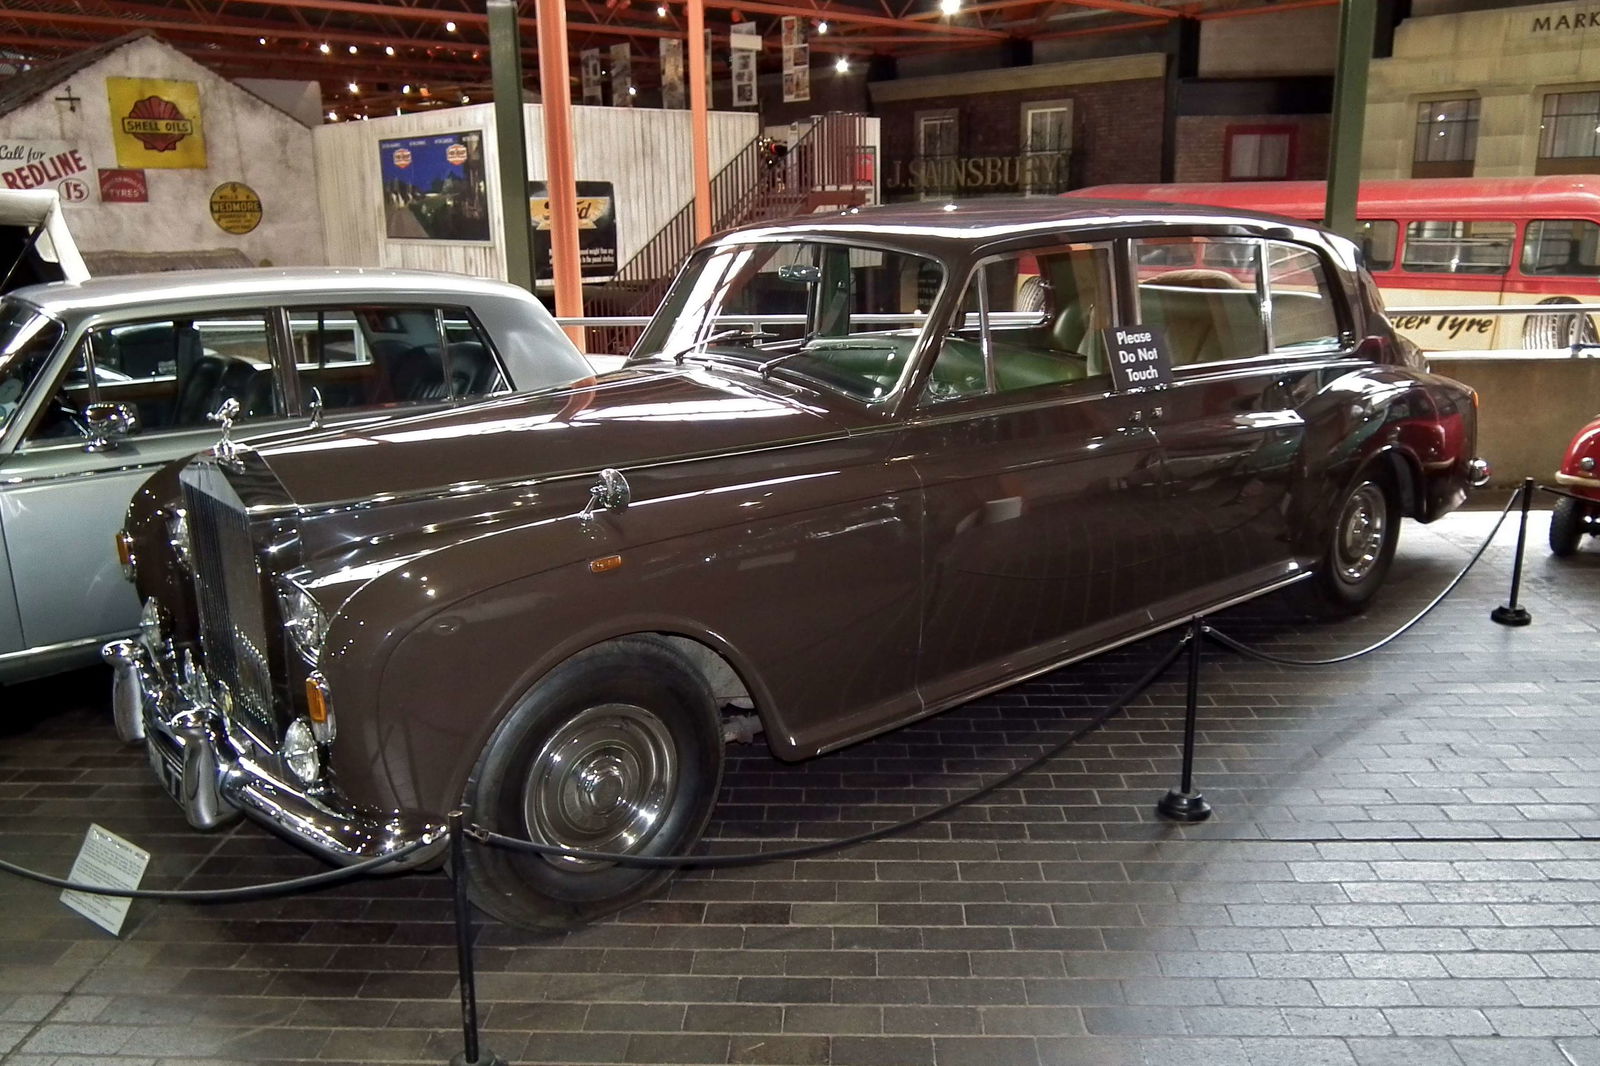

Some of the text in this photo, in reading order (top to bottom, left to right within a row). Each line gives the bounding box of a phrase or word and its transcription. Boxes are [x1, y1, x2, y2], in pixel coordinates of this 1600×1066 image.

[1533, 12, 1600, 31] MARK
[127, 120, 189, 132] SHELL OILS
[0, 145, 46, 163] Call for
[2, 149, 87, 189] REDLINE
[110, 188, 140, 198] TYRES
[212, 202, 259, 211] WEDMORE
[1116, 331, 1152, 345] Please
[1118, 347, 1158, 364] Do Not
[1125, 365, 1159, 382] Touch
